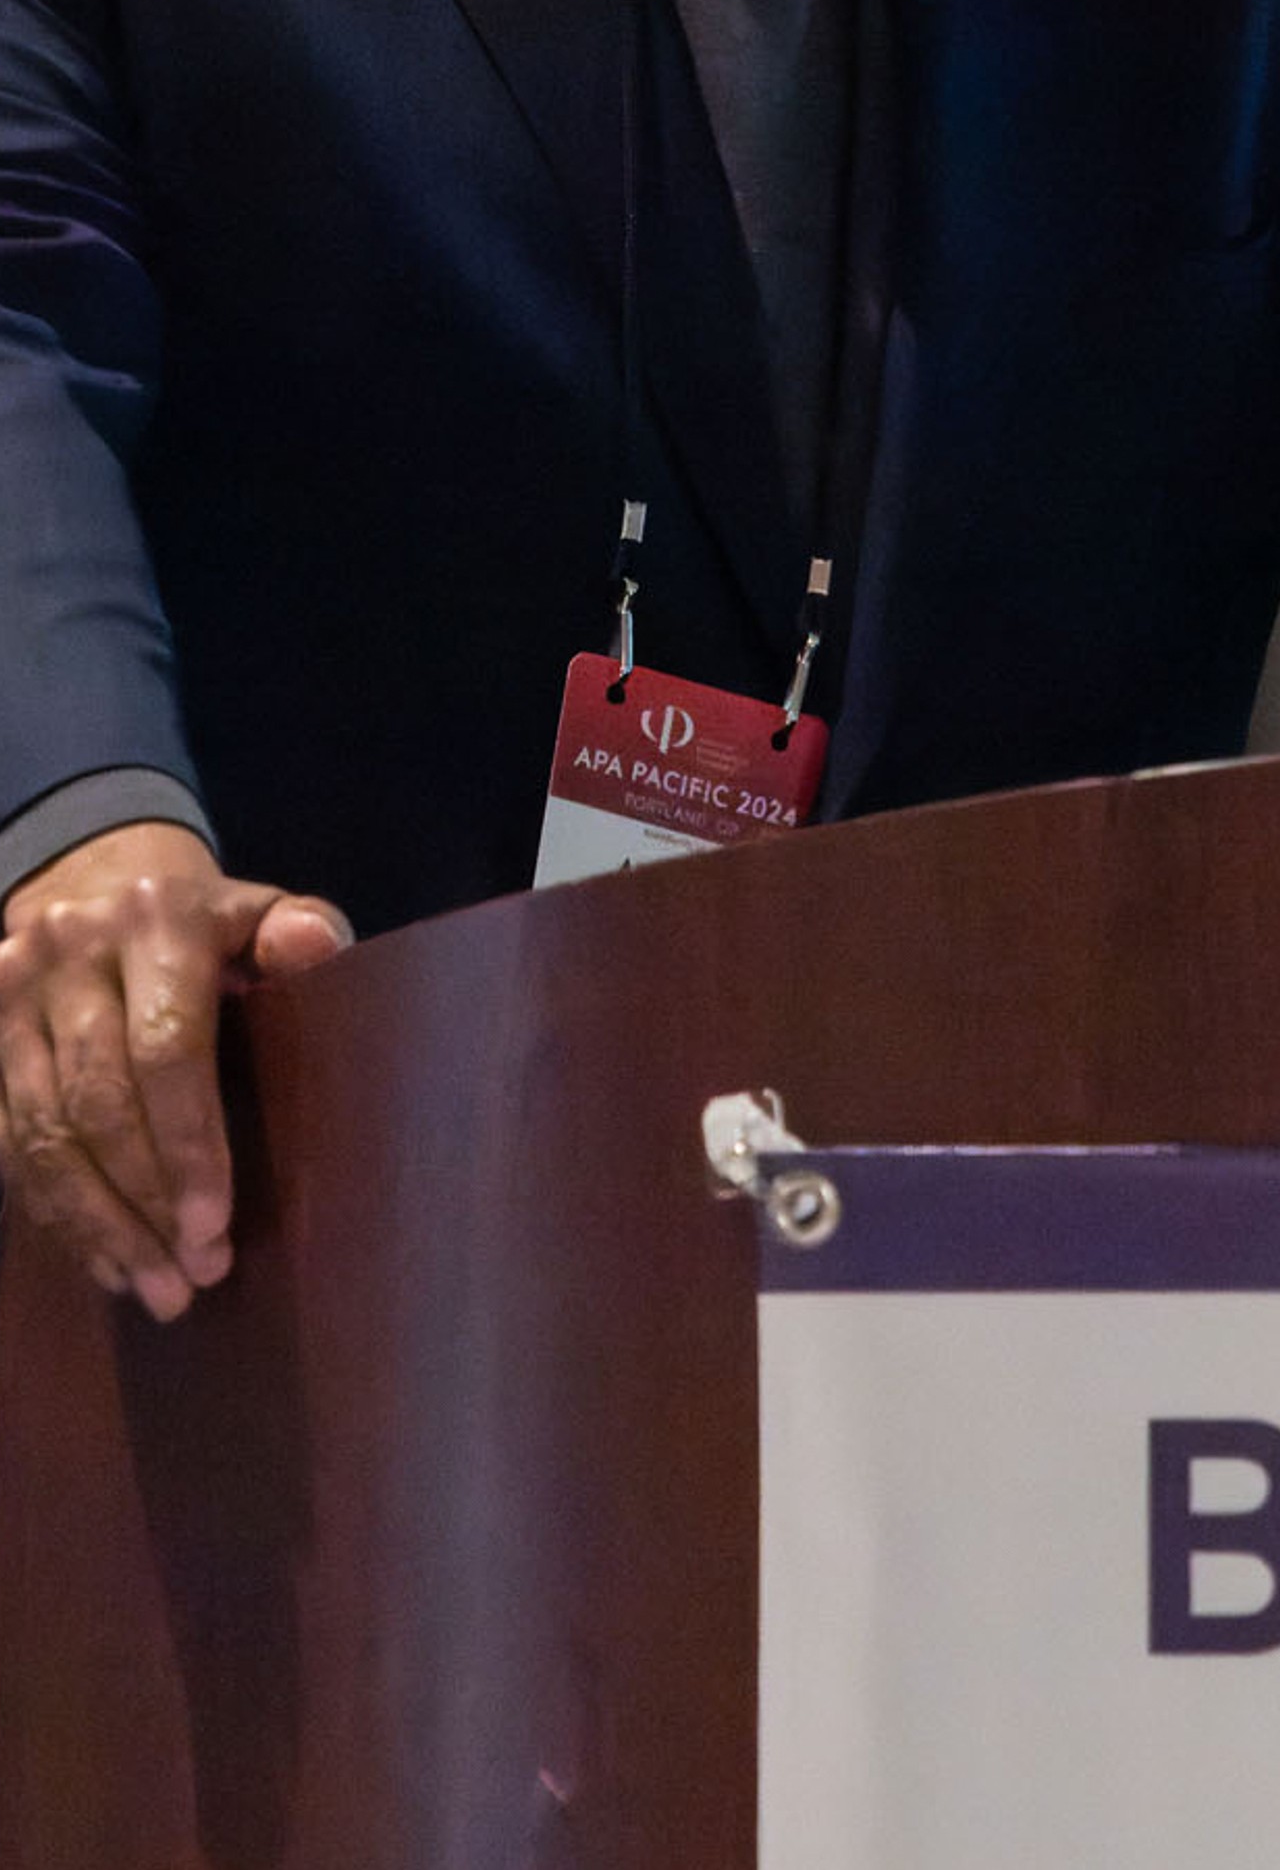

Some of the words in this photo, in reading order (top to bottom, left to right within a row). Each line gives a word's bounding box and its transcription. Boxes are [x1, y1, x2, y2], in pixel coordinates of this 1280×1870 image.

[574, 746, 622, 778] APA
[631, 761, 729, 808] PACIFIC
[736, 791, 797, 827] 2024
